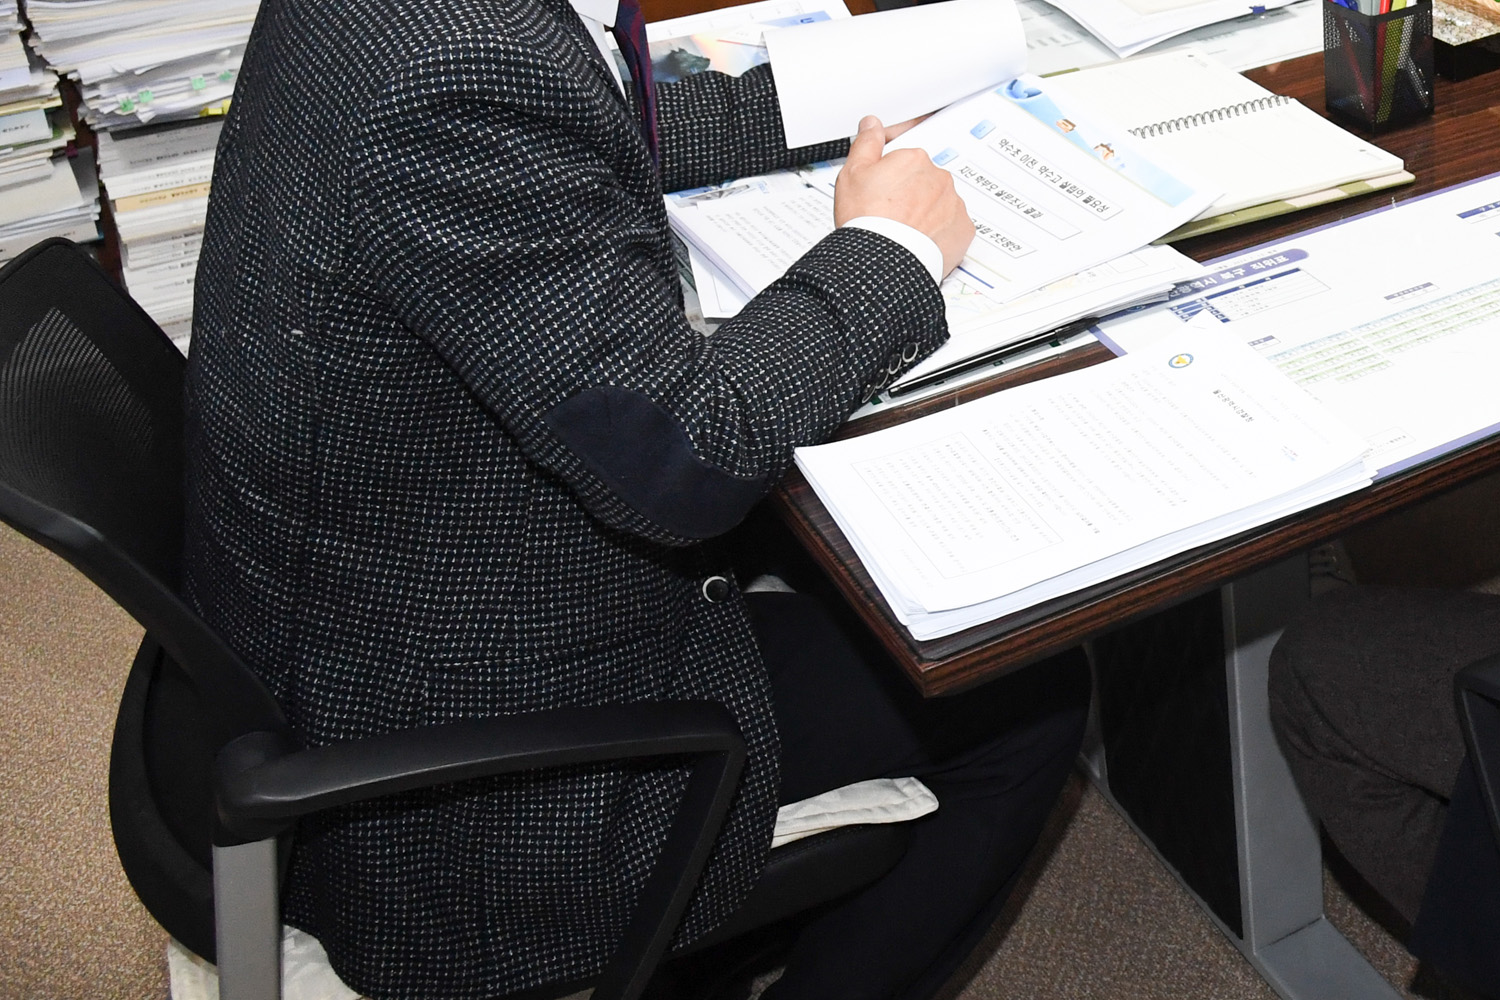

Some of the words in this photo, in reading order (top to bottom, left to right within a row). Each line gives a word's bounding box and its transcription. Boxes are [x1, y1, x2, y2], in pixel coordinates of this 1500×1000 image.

[959, 165, 977, 178] 지난
[975, 175, 999, 192] 학부모
[994, 190, 1028, 209] 설문조사
[1023, 207, 1044, 219] 결과
[998, 138, 1022, 157] 약수초
[1038, 165, 1062, 184] 약수고
[1059, 181, 1087, 198] 설립의
[1082, 195, 1110, 213] 필요성
[989, 233, 1023, 252] 추진방안
[1220, 267, 1246, 280] 북구
[1249, 255, 1290, 271] 직위표
